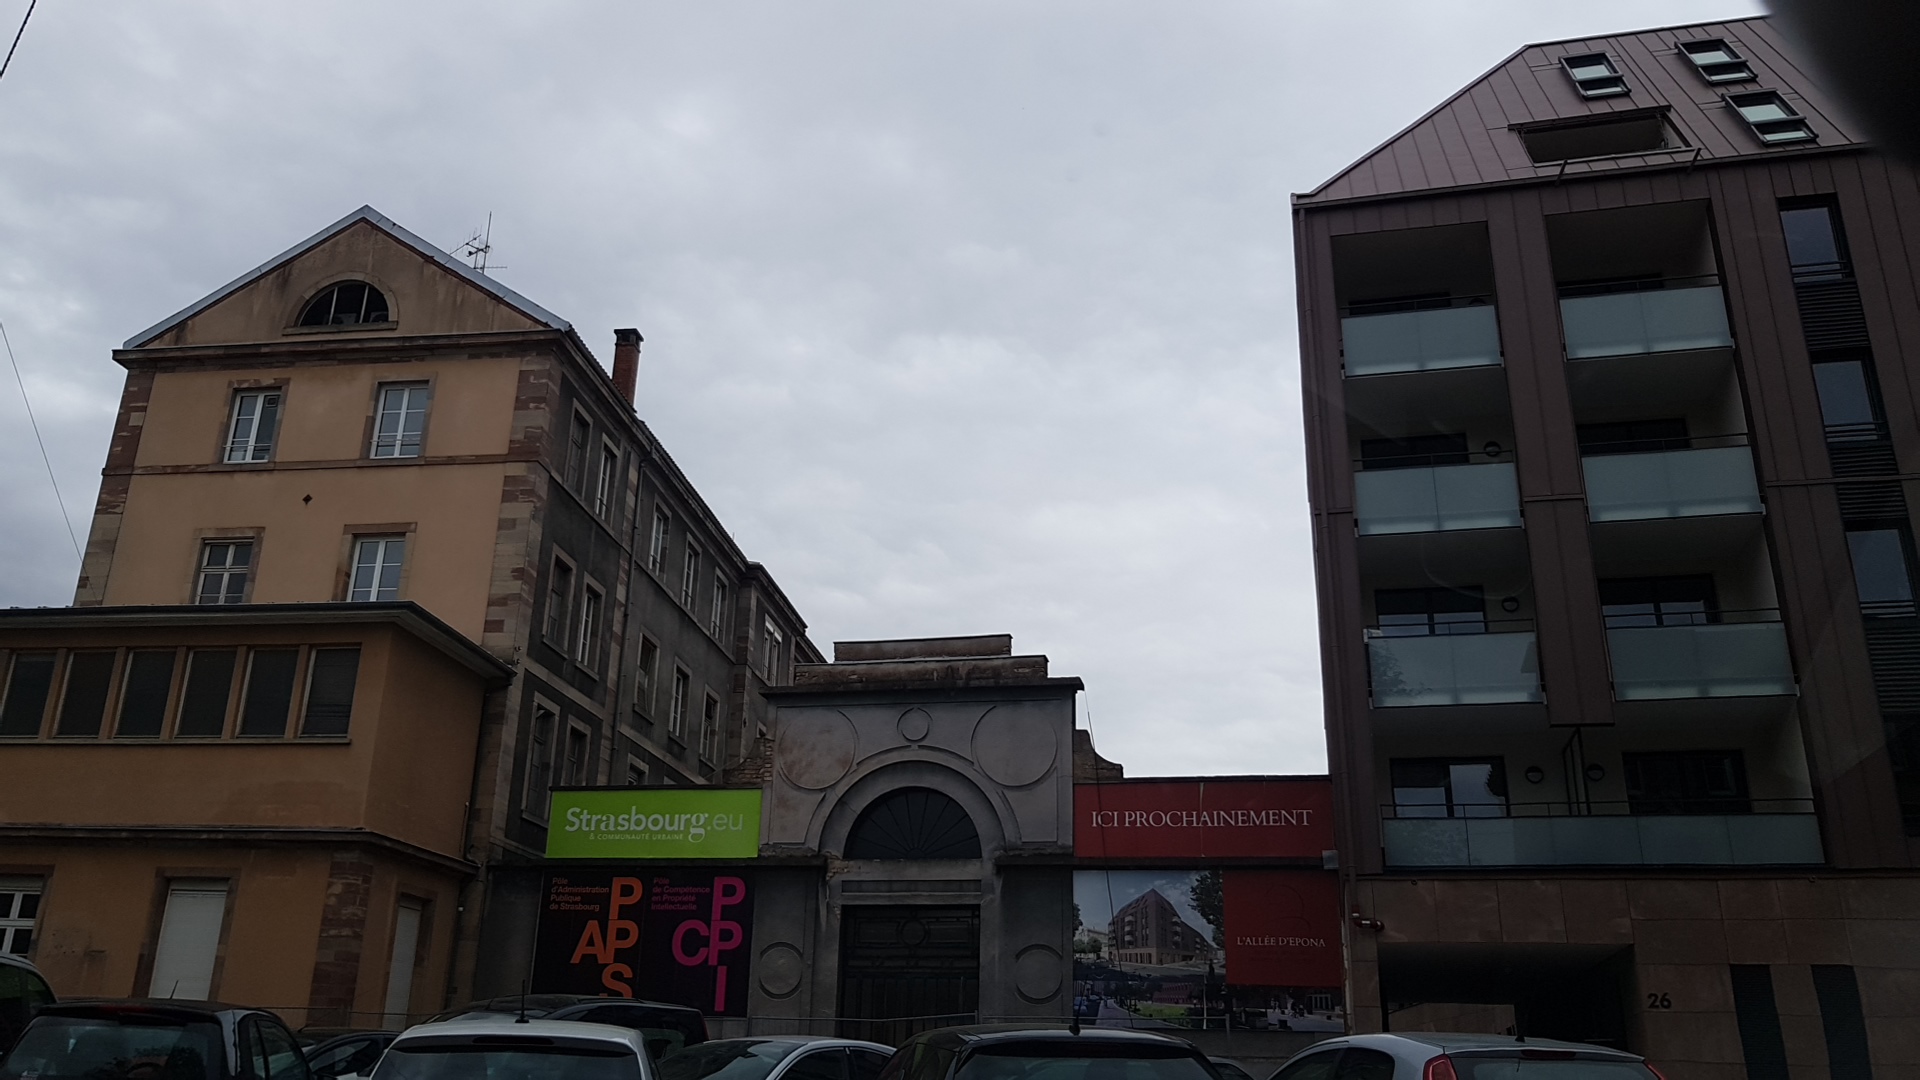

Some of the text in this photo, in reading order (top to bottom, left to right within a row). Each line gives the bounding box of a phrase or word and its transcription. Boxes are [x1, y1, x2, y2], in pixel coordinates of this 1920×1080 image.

[1091, 809, 1313, 828] ICI PROCHAINEMENT
[564, 805, 744, 843] Strasbourg.eu
[597, 832, 649, 841] COMMUNAUTÉ
[652, 833, 684, 841] URBAINE
[552, 877, 568, 885] Pôle
[551, 886, 610, 894] d'Administration
[652, 885, 711, 894] de Compétence
[550, 894, 582, 903] Publique
[560, 903, 600, 912] Strasbourg
[1236, 934, 1326, 948] L'ALLÉE D'EPONA
[1647, 992, 1672, 1009] 26
